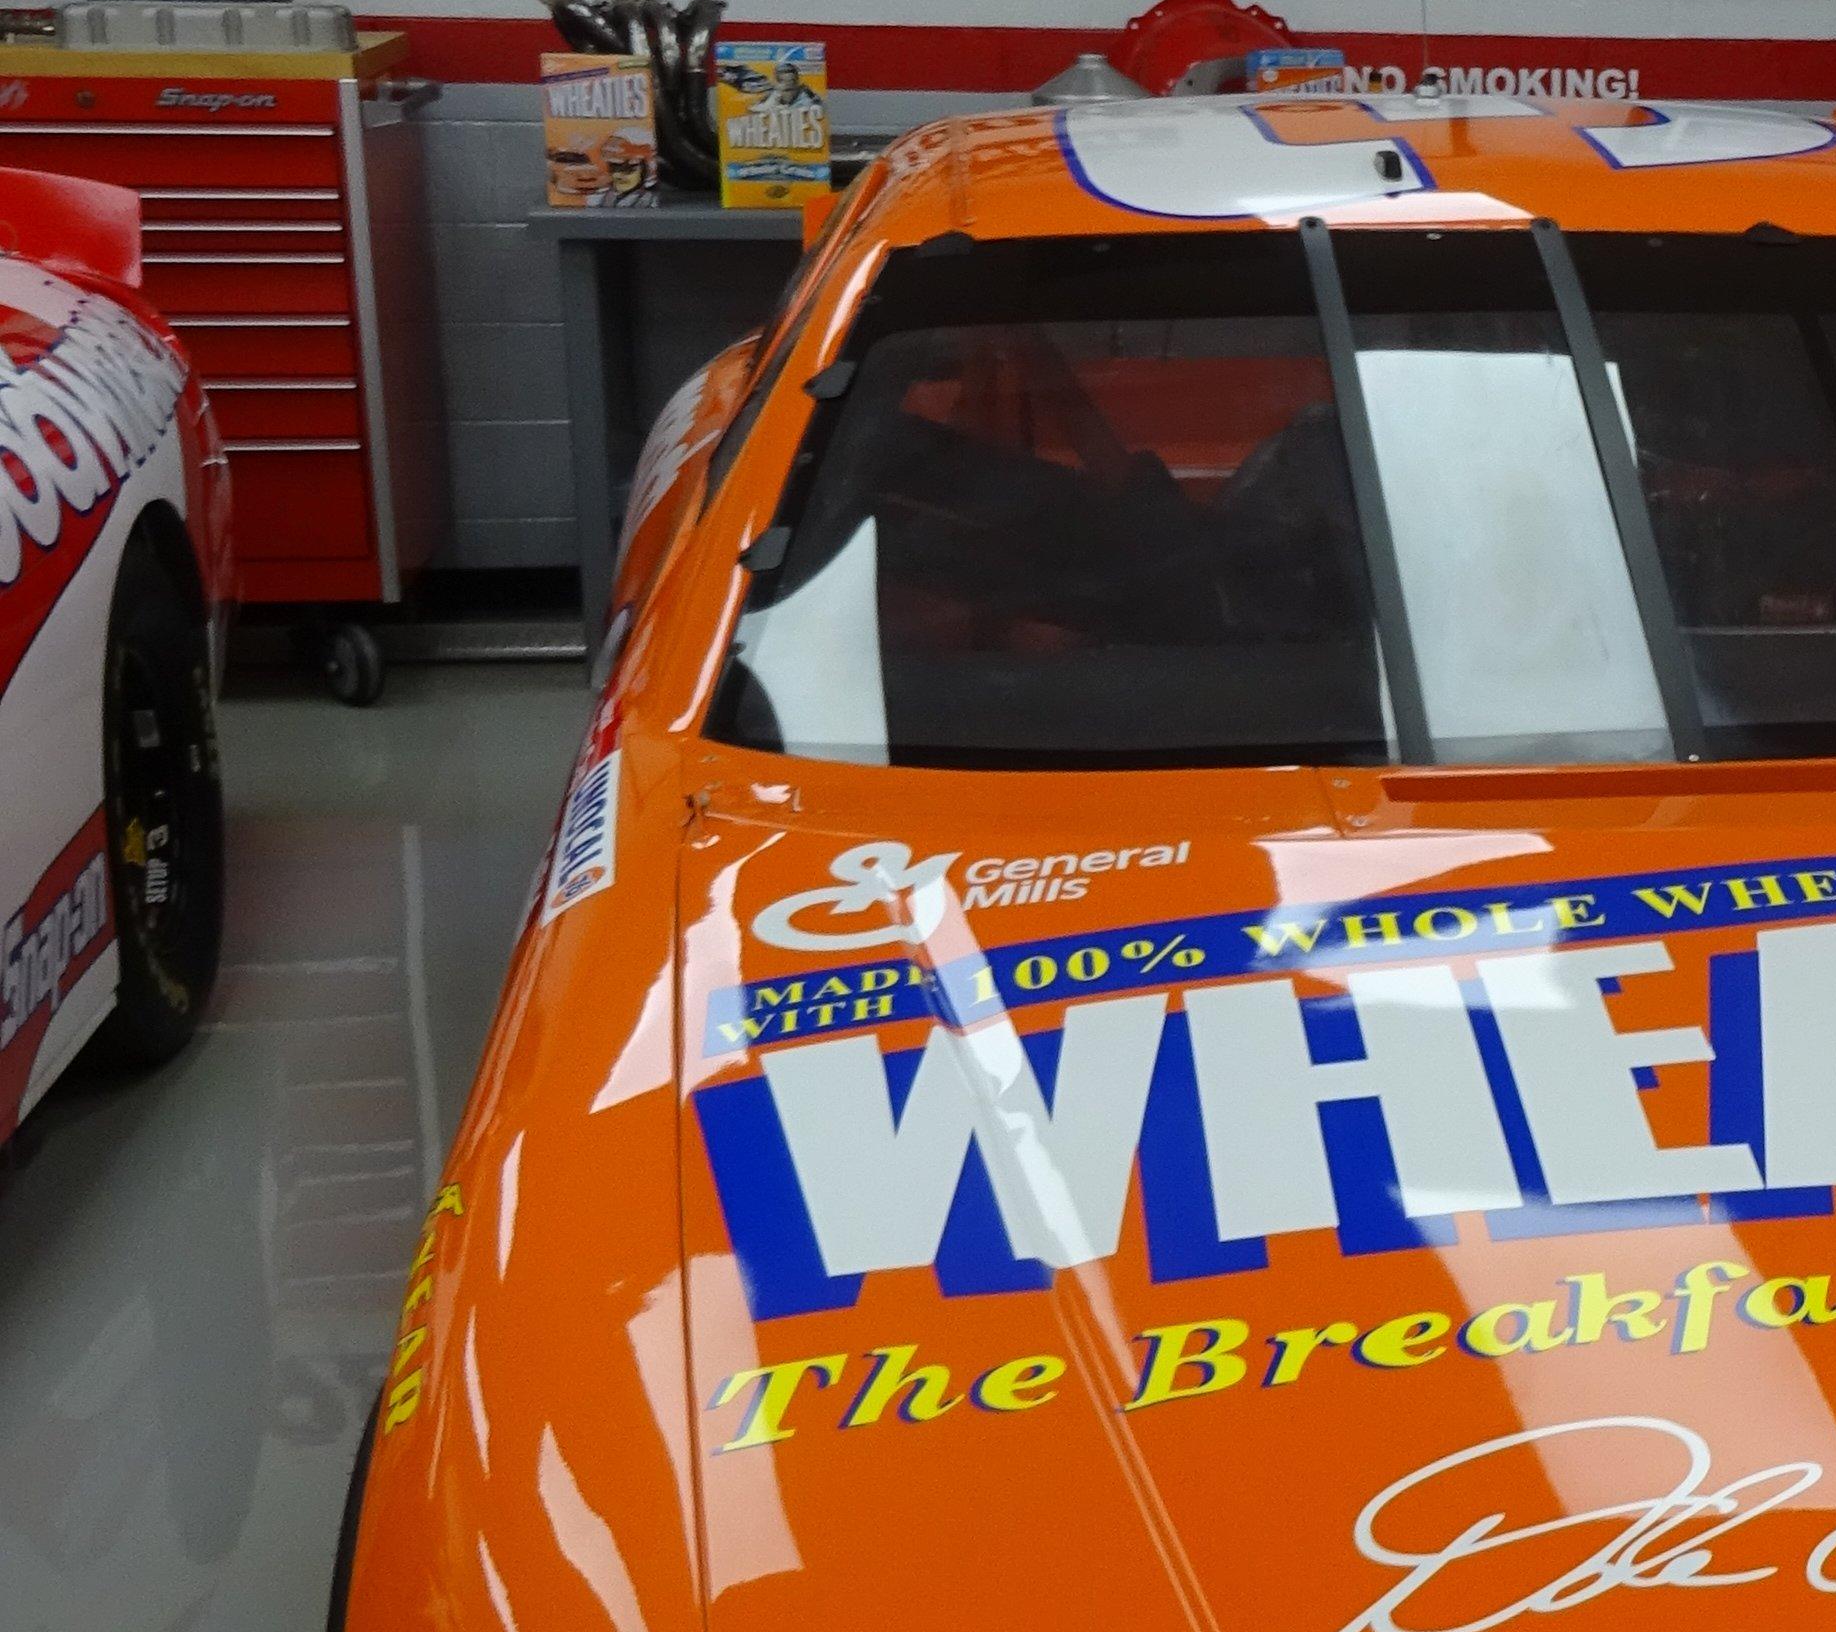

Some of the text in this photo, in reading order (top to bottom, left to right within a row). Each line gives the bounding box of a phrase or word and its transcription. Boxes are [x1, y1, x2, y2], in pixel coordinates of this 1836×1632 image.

[549, 73, 648, 119] WHEATIES
[1343, 65, 1407, 96] NO
[727, 104, 825, 150] WHEATIES
[963, 840, 1192, 886] General
[962, 878, 1092, 911] Mills
[966, 933, 1208, 1009] 100%
[1241, 892, 1607, 960] WHOLE
[715, 992, 896, 1046] WITH
[708, 1343, 1067, 1456] The
